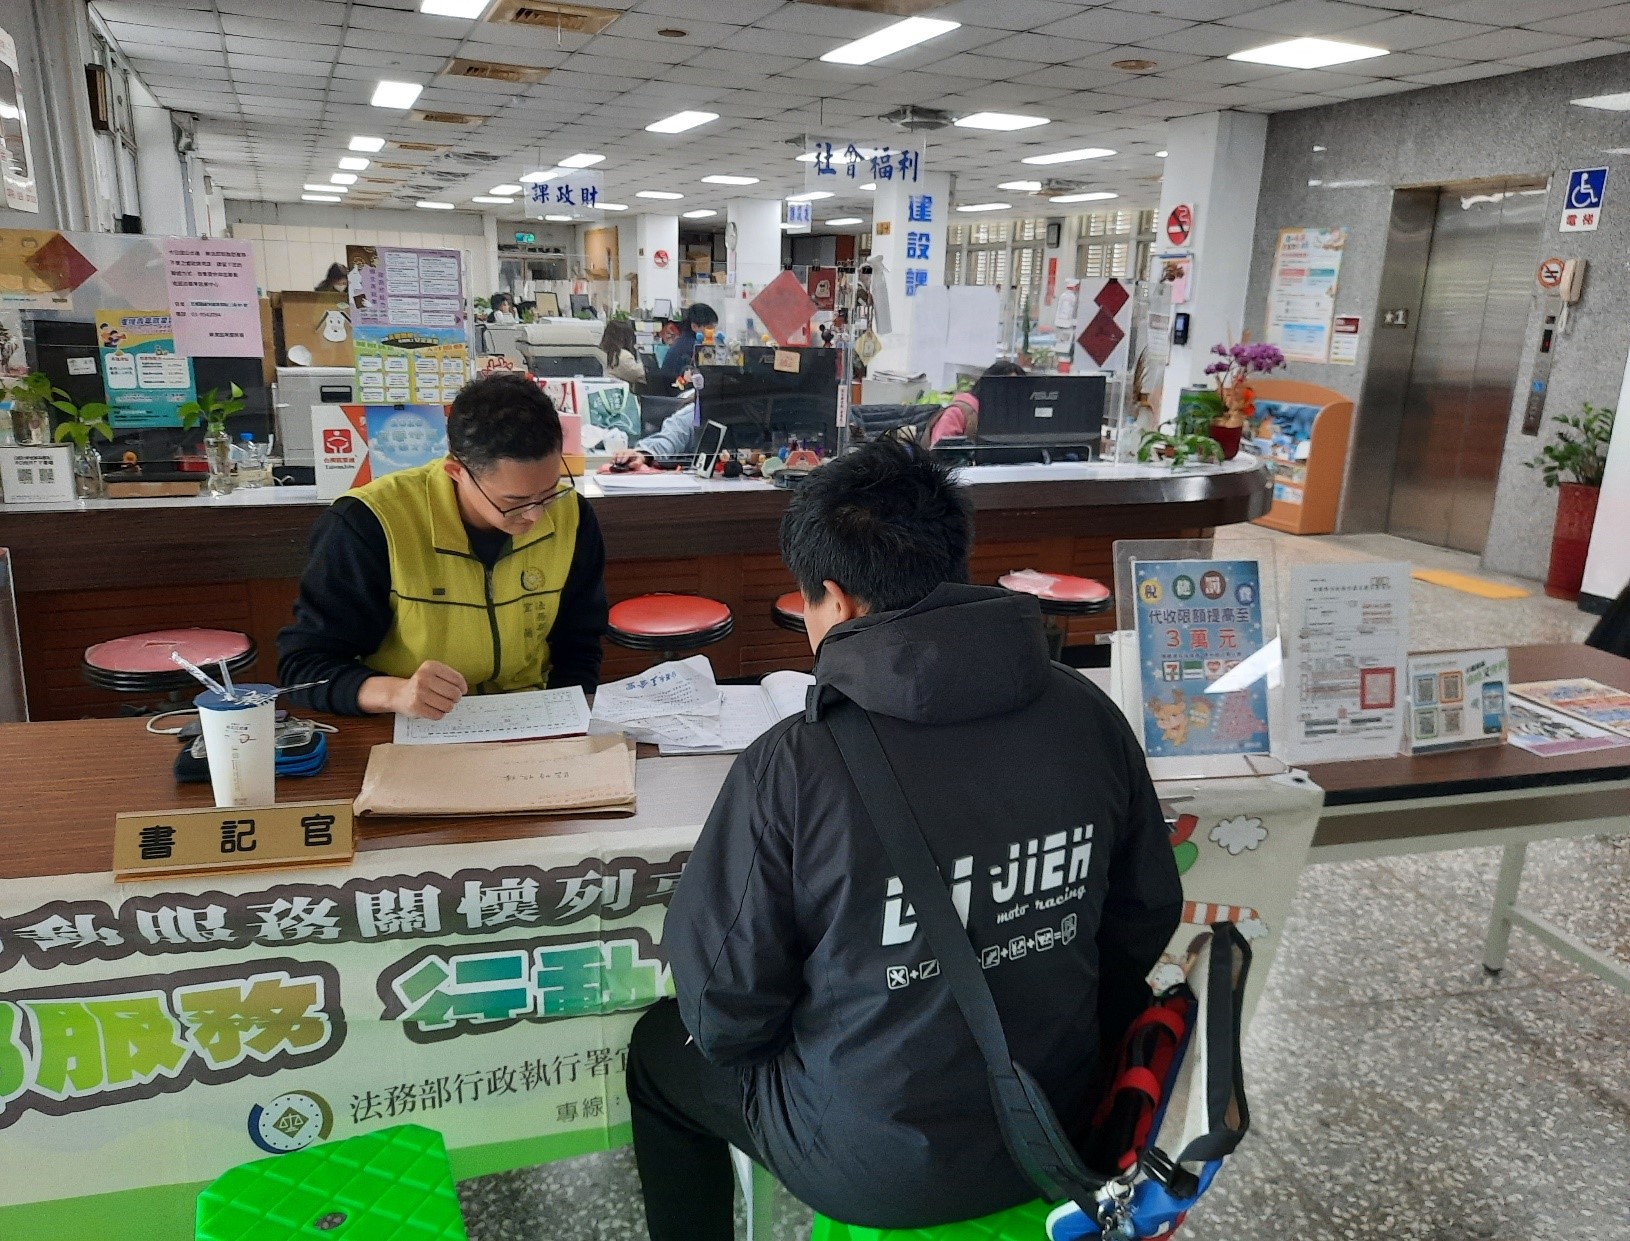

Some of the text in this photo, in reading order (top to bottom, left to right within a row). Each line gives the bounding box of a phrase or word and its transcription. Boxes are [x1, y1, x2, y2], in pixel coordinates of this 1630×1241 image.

[813, 142, 919, 183] 社會福利
[1149, 607, 1250, 625] 代收限額提高至
[138, 812, 336, 861] 書記官
[996, 884, 1087, 925] moto racing
